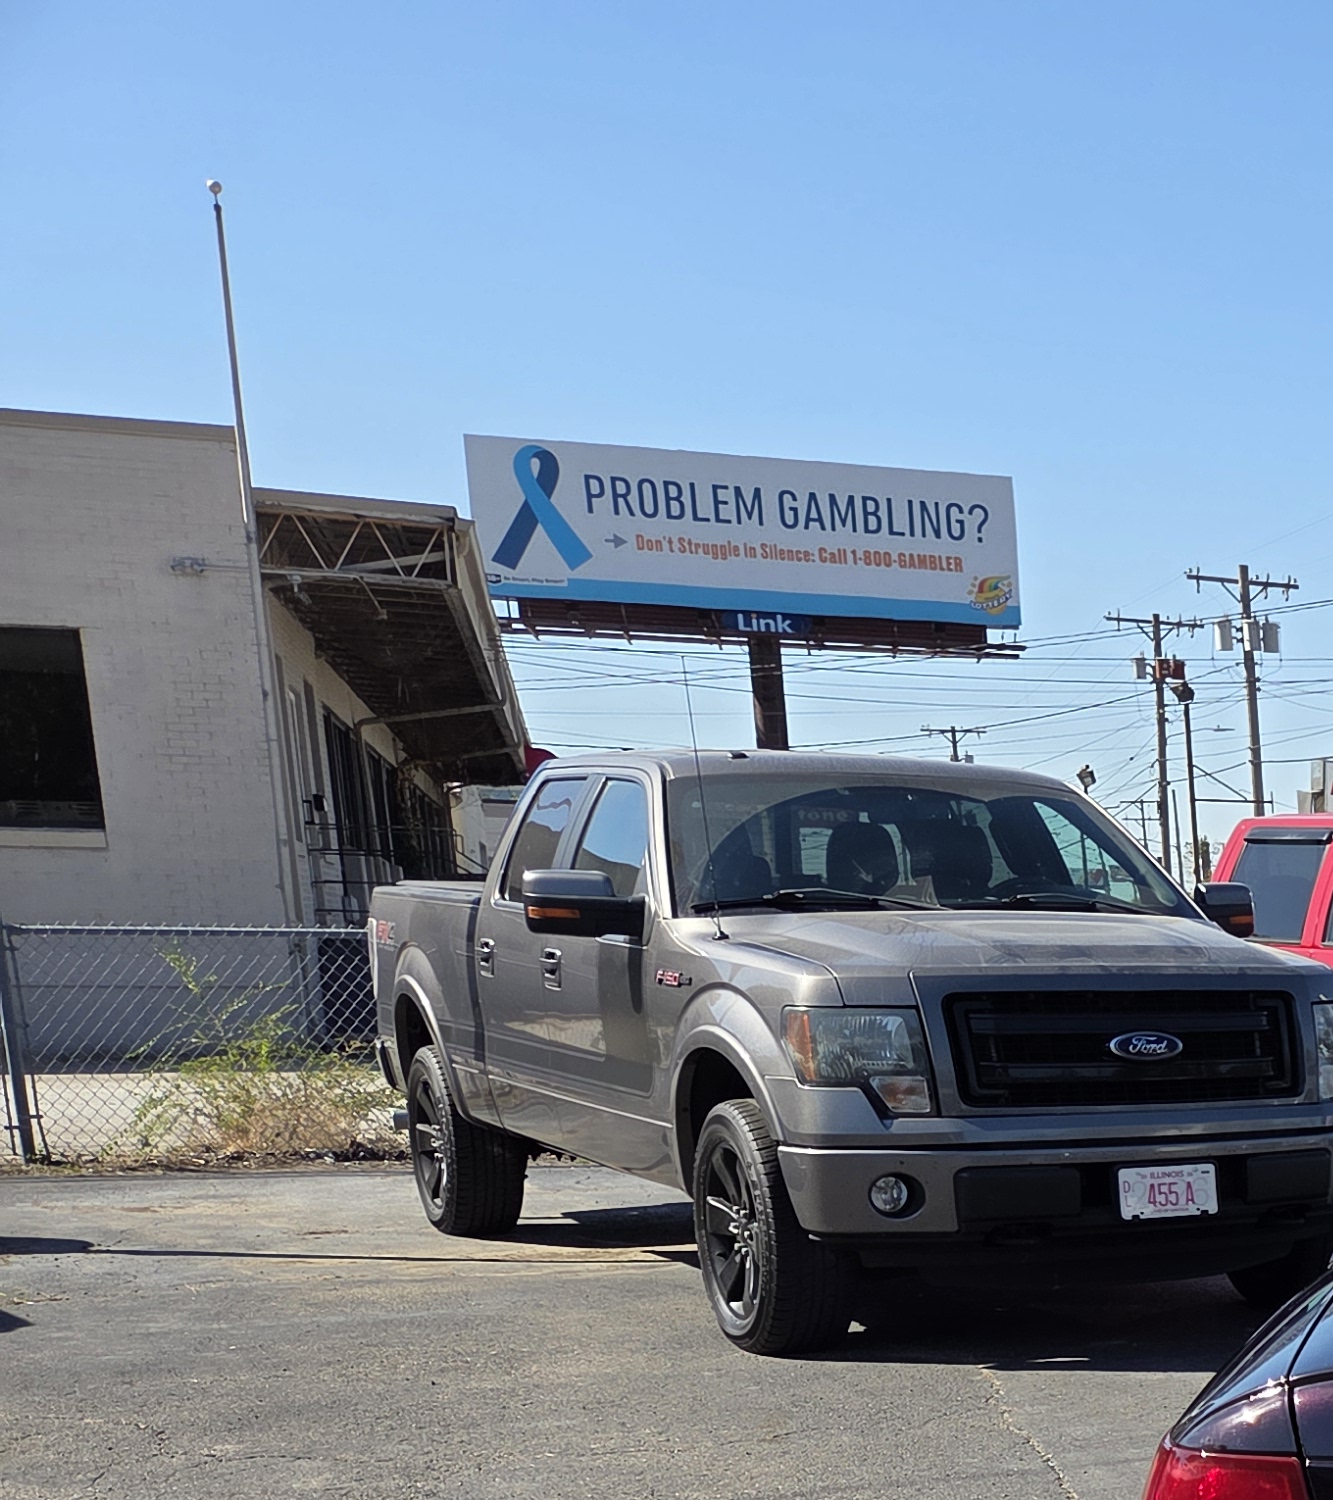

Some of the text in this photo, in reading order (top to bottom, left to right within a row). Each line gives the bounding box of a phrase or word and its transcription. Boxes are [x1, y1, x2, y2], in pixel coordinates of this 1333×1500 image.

[583, 473, 989, 544] PROBLEM GAMBLING?
[635, 533, 675, 554] Don't
[678, 537, 741, 561] Struggle
[760, 543, 816, 563] Silence:
[818, 547, 848, 565] Call
[850, 549, 964, 573] 1-800-GAMBLER
[737, 613, 796, 634] Link
[1129, 1035, 1168, 1054] Ford
[1147, 1182, 1179, 1207] 455
